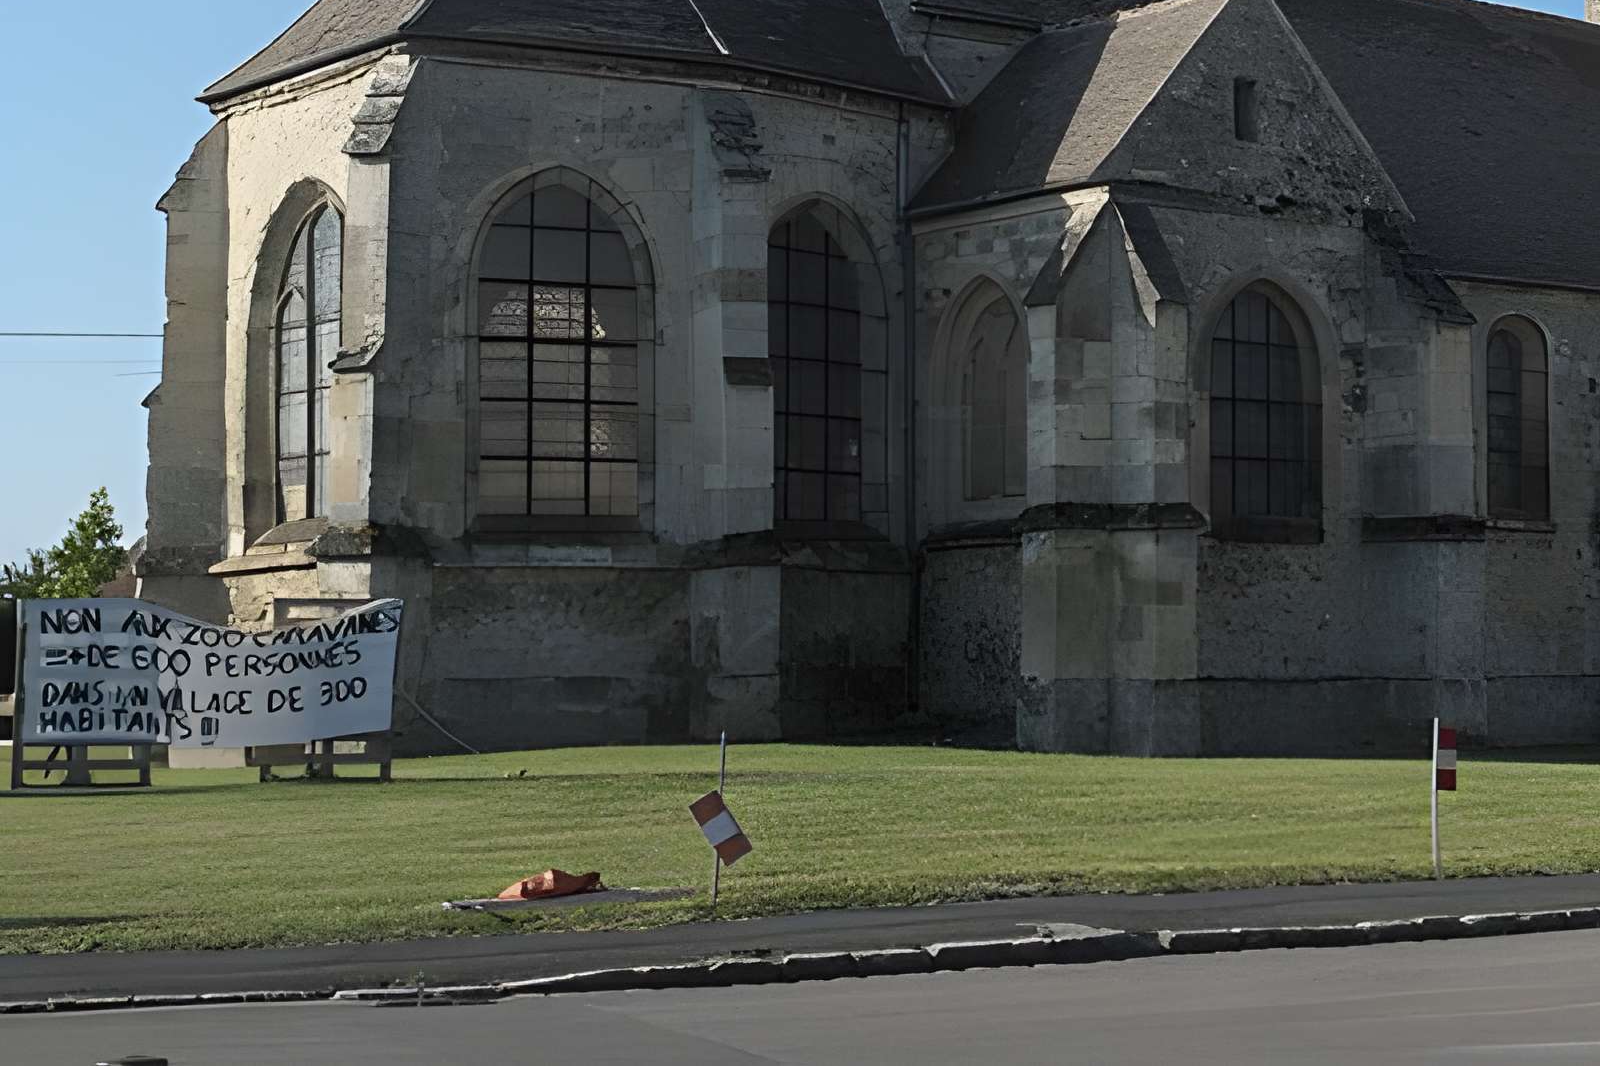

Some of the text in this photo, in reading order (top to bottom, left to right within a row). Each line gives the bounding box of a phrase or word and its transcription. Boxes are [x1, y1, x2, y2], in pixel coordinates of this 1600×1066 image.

[41, 608, 101, 634] NON
[121, 610, 172, 640] AUX
[87, 644, 120, 668] DE
[205, 640, 361, 677] PERSONNES
[42, 680, 104, 707] DANS
[267, 686, 304, 713] DE
[320, 677, 367, 706] 300
